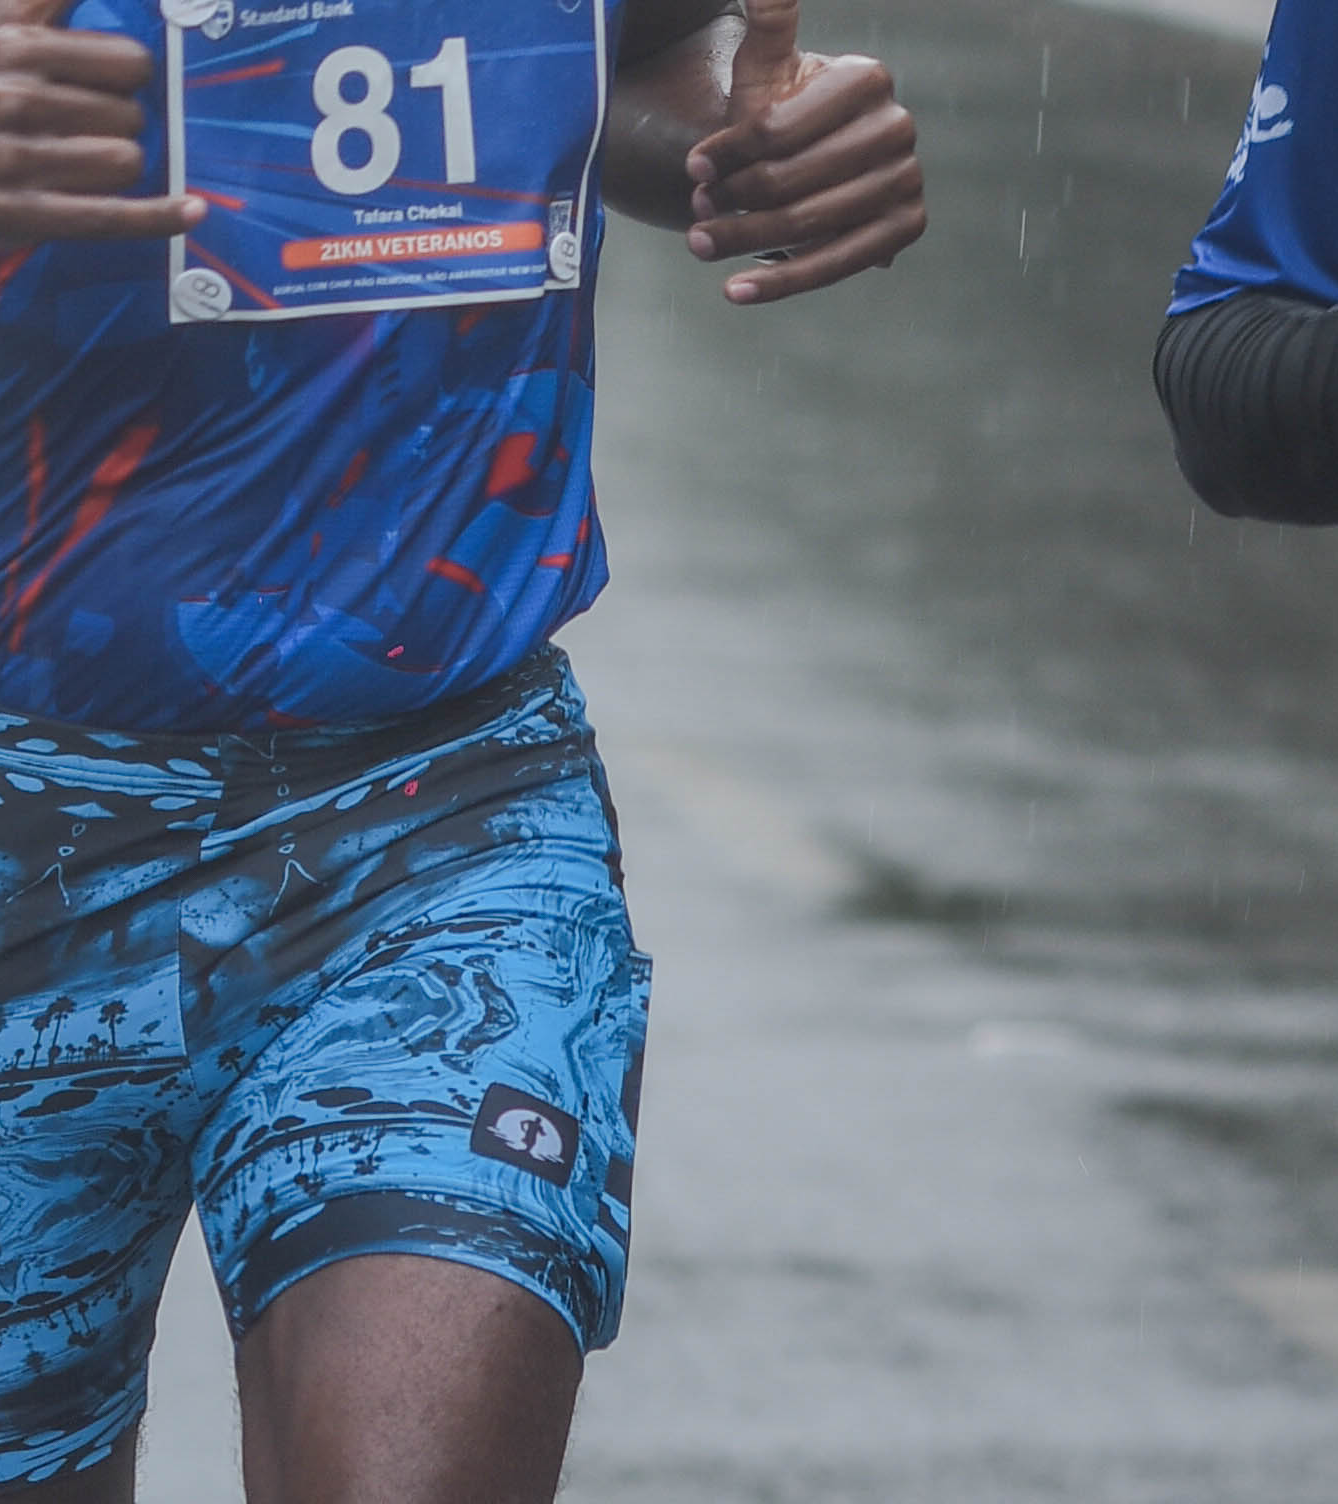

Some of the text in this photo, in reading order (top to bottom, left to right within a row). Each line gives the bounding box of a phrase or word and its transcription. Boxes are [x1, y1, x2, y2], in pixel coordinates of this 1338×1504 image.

[239, 1, 309, 28] Standard
[311, 37, 476, 195] 81
[353, 208, 403, 225] Tafara
[320, 230, 503, 261] 21KM VETERANOS
